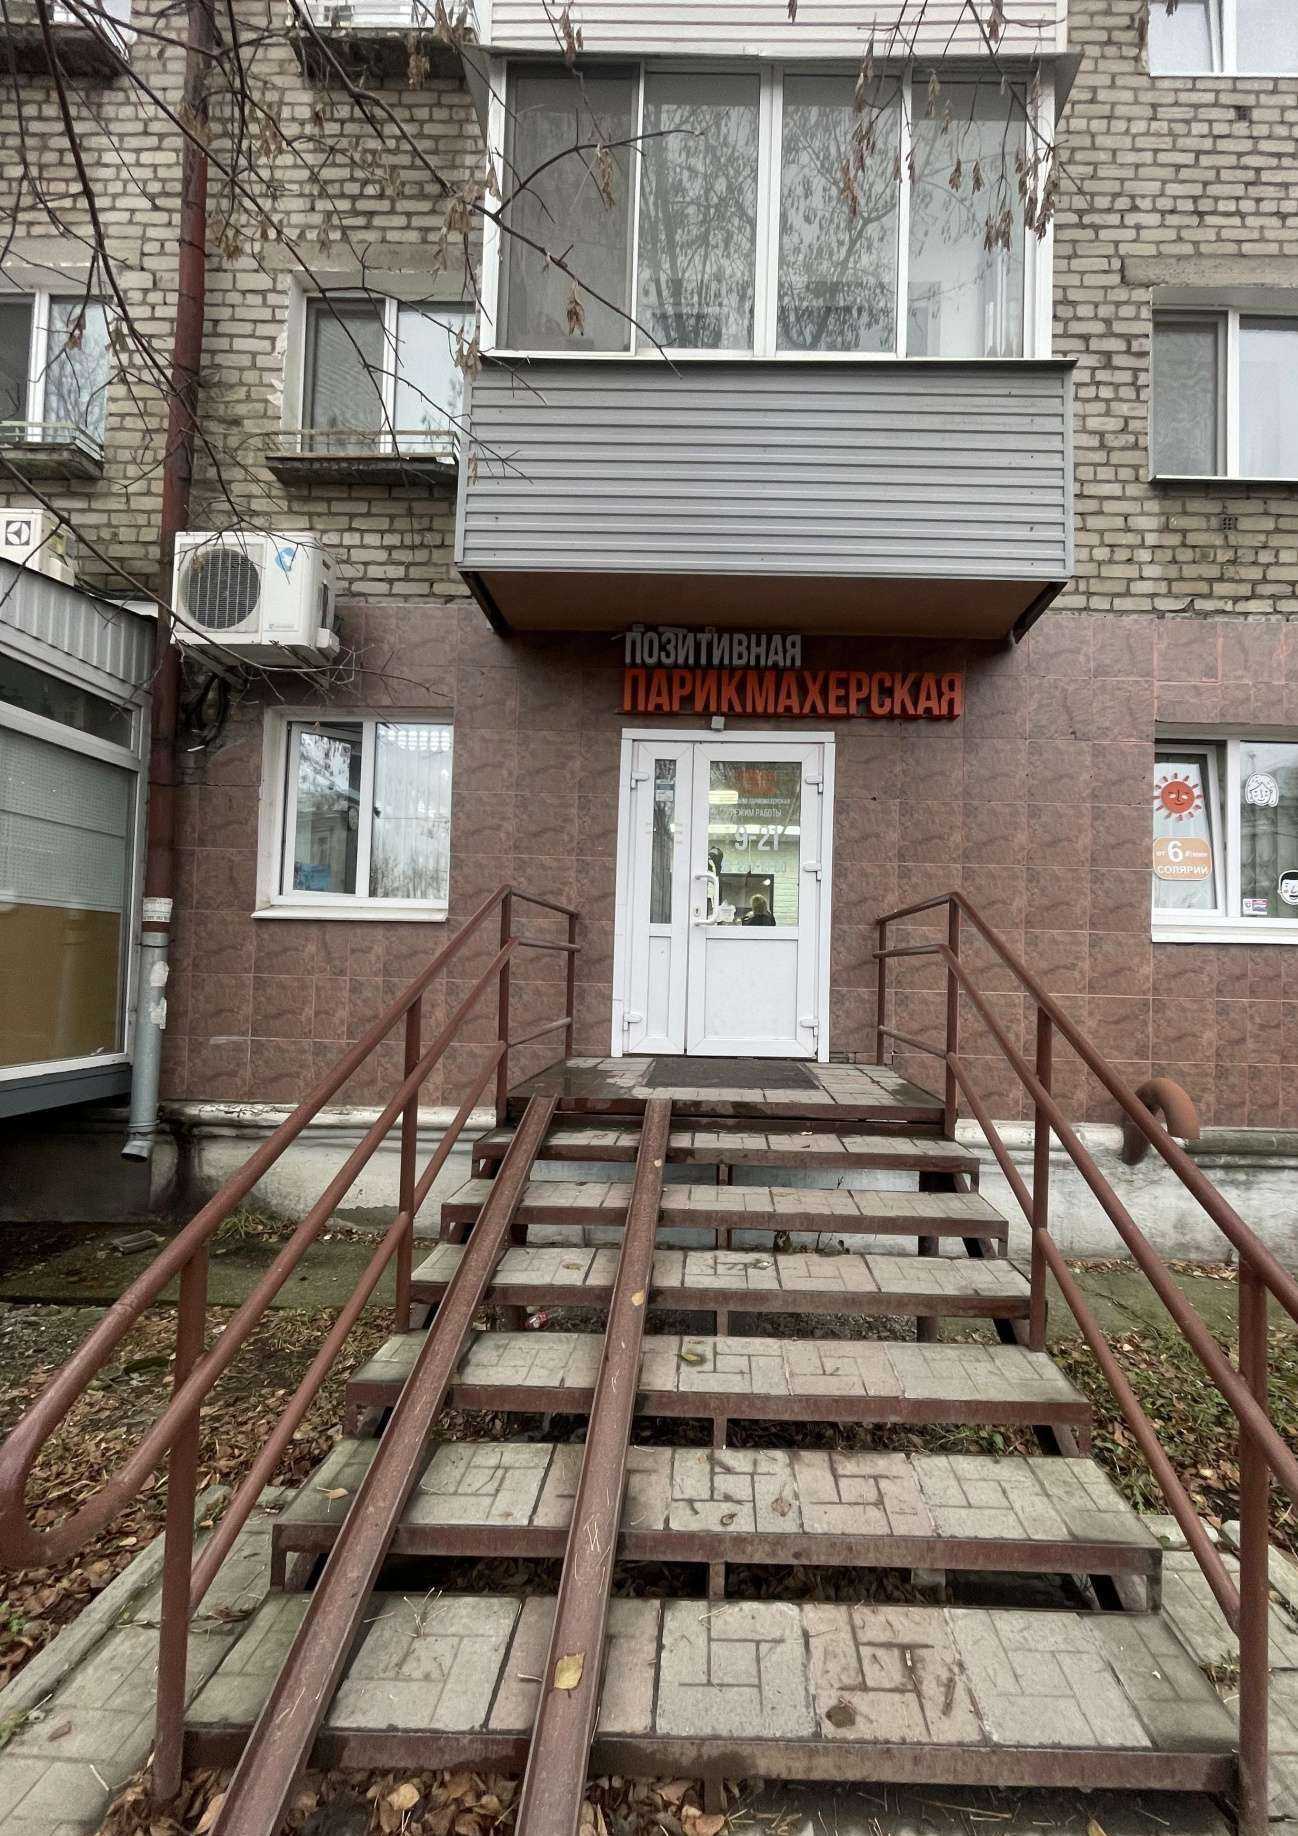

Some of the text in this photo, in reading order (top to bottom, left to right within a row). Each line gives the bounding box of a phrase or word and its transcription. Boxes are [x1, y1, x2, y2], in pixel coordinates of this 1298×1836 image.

[625, 630, 801, 667] ПОЗИТИВНАЯ
[623, 667, 964, 716] ПАРИКМАХЕРСКАЯ
[756, 808, 782, 817] РАБОТЫ
[1168, 841, 1183, 863] 6
